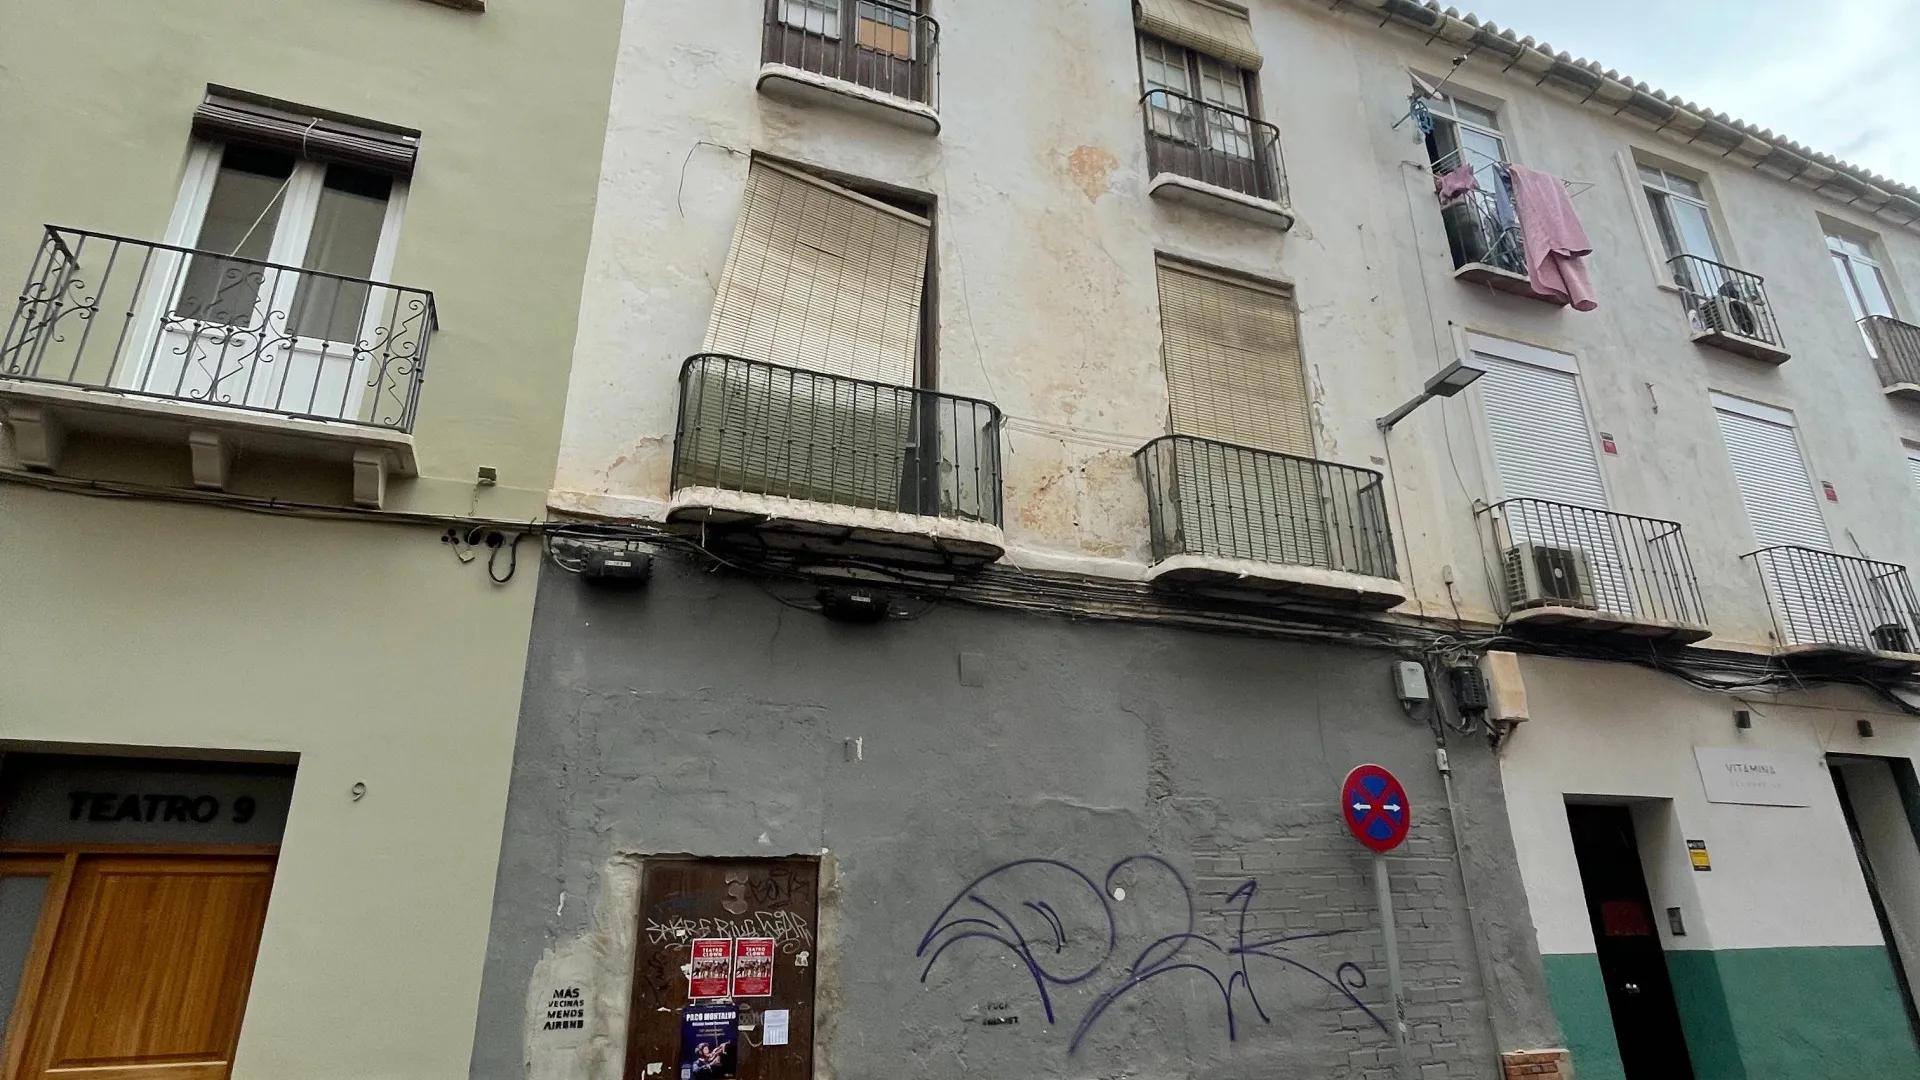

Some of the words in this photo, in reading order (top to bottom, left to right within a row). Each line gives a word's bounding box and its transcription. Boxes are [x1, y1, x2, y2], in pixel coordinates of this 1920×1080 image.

[1725, 763, 1776, 774] VITAMINA
[352, 781, 367, 801] 9
[68, 792, 219, 823] TEATRO
[232, 795, 256, 823] 9
[553, 985, 580, 999] MÁS
[547, 1009, 584, 1019] MENOS
[686, 1013, 703, 1021] PACO
[704, 1011, 736, 1020] MONTALVO
[543, 1020, 584, 1030] AIRBNB
